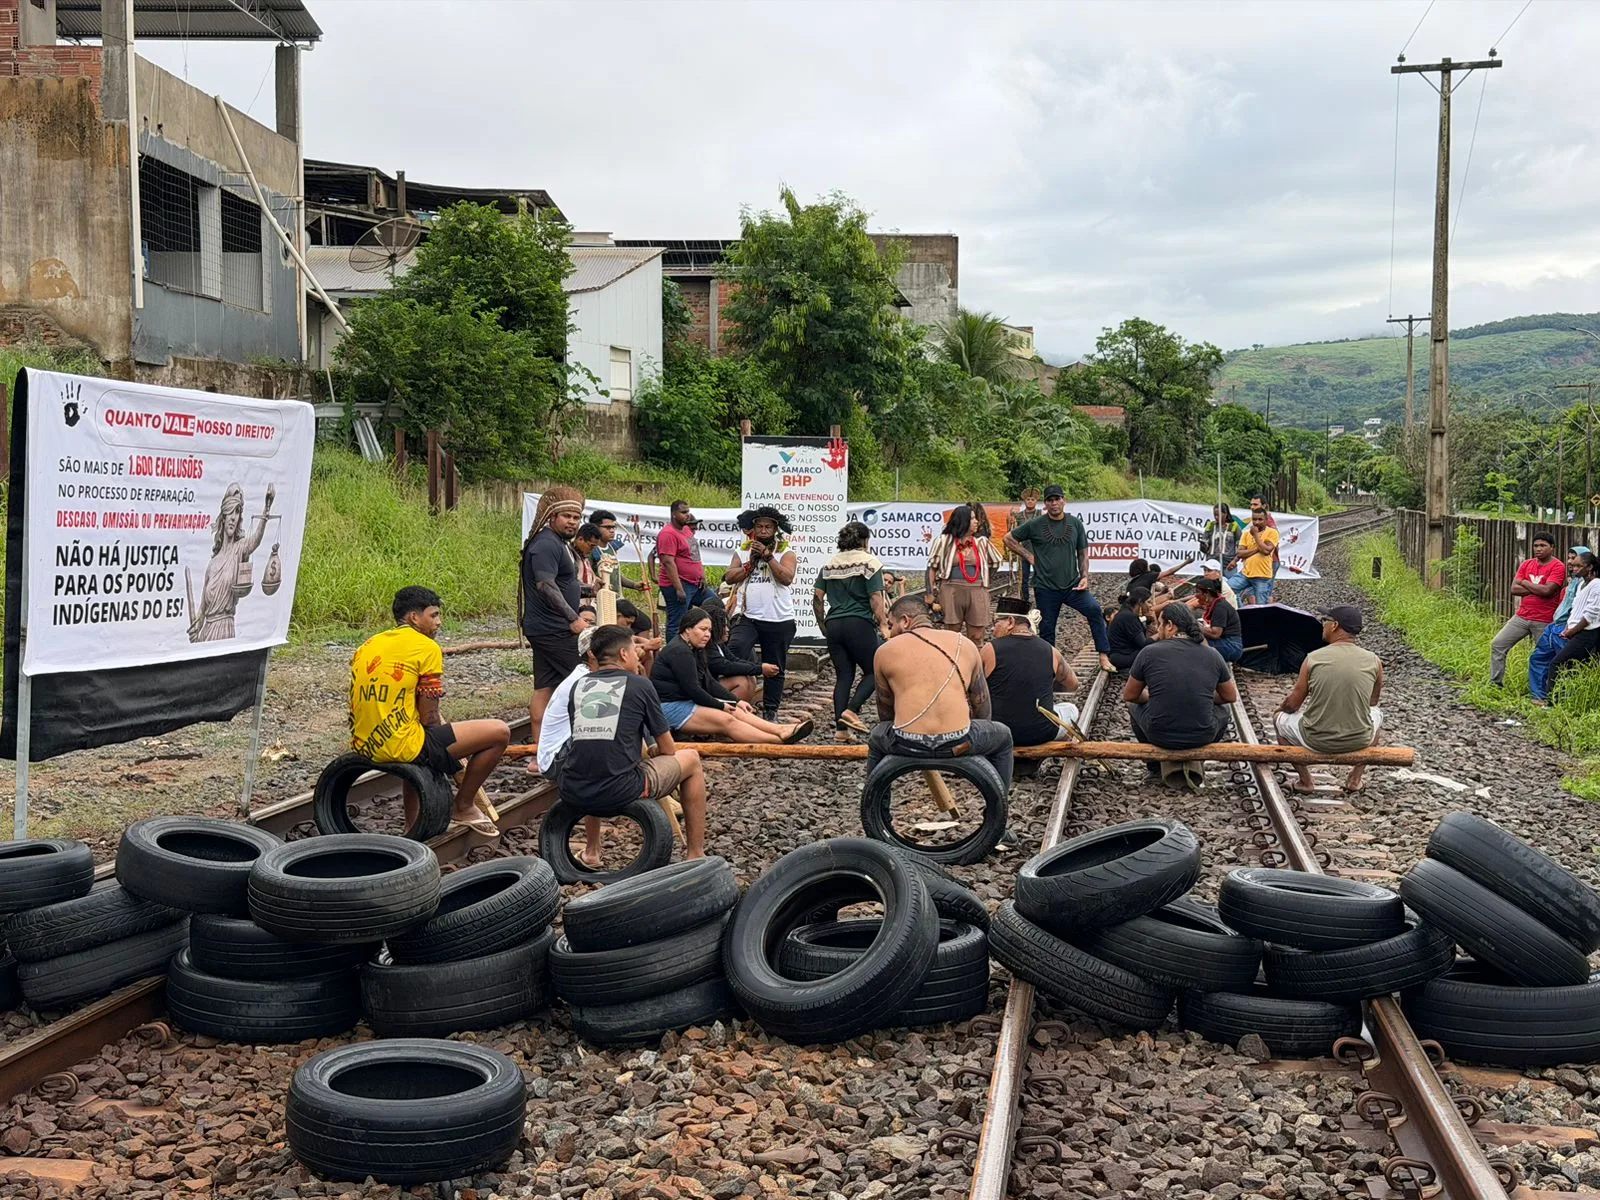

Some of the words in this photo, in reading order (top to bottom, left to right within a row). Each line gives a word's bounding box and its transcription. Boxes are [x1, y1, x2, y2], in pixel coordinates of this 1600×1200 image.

[105, 409, 162, 429] QUANTO
[164, 415, 195, 433] VALE
[196, 419, 232, 435] NOSSO
[235, 424, 275, 440] DIREITO?
[58, 456, 81, 473] SÃO
[84, 460, 109, 475] MAIS
[111, 462, 124, 476] DE
[128, 454, 153, 476] 1.600
[155, 454, 203, 479] EXCLUSÕES
[781, 466, 822, 474] SAMARCO
[782, 475, 812, 487] BHP
[58, 484, 76, 498] NO
[78, 485, 128, 500] PROCESSO
[130, 487, 143, 501] DE
[144, 487, 196, 506] REPARAÇÃO.
[745, 492, 752, 500] A
[754, 492, 781, 500] LAMA
[783, 493, 834, 501] ENVENENOU
[798, 504, 805, 512] O
[807, 504, 840, 512] NOSSO
[57, 510, 99, 530] DESCASO,
[102, 509, 139, 529] OMISSÃO
[141, 513, 151, 529] OU
[153, 511, 211, 534] PREVARICAÇÃO?
[798, 514, 837, 522] NOSSOS
[881, 512, 942, 522] SAMARCO
[1087, 512, 1137, 525] JUSTIÇA
[1142, 513, 1174, 524] VALE
[708, 522, 740, 532] OCEA
[791, 525, 815, 533] GUES
[870, 529, 911, 538] NOSSO
[1086, 529, 1112, 541] QUE
[1116, 527, 1143, 540] NÃO
[1146, 531, 1177, 541] VALE
[56, 539, 94, 567] NÃO
[98, 540, 121, 566] HÁ
[122, 545, 179, 572] JUSTIÇA
[800, 546, 824, 554] VIDA,
[870, 546, 930, 557] NCESTRAL
[1088, 543, 1138, 557] INÁRIOS
[1142, 548, 1206, 561] TUPINIKIM
[54, 574, 98, 596] PARA
[103, 573, 123, 594] OS
[126, 572, 175, 593] POVOS
[53, 597, 139, 626] INDÍGENAS
[142, 599, 163, 620] DO
[166, 597, 184, 618] ES!
[359, 677, 389, 702] NÃO
[394, 687, 406, 706] A
